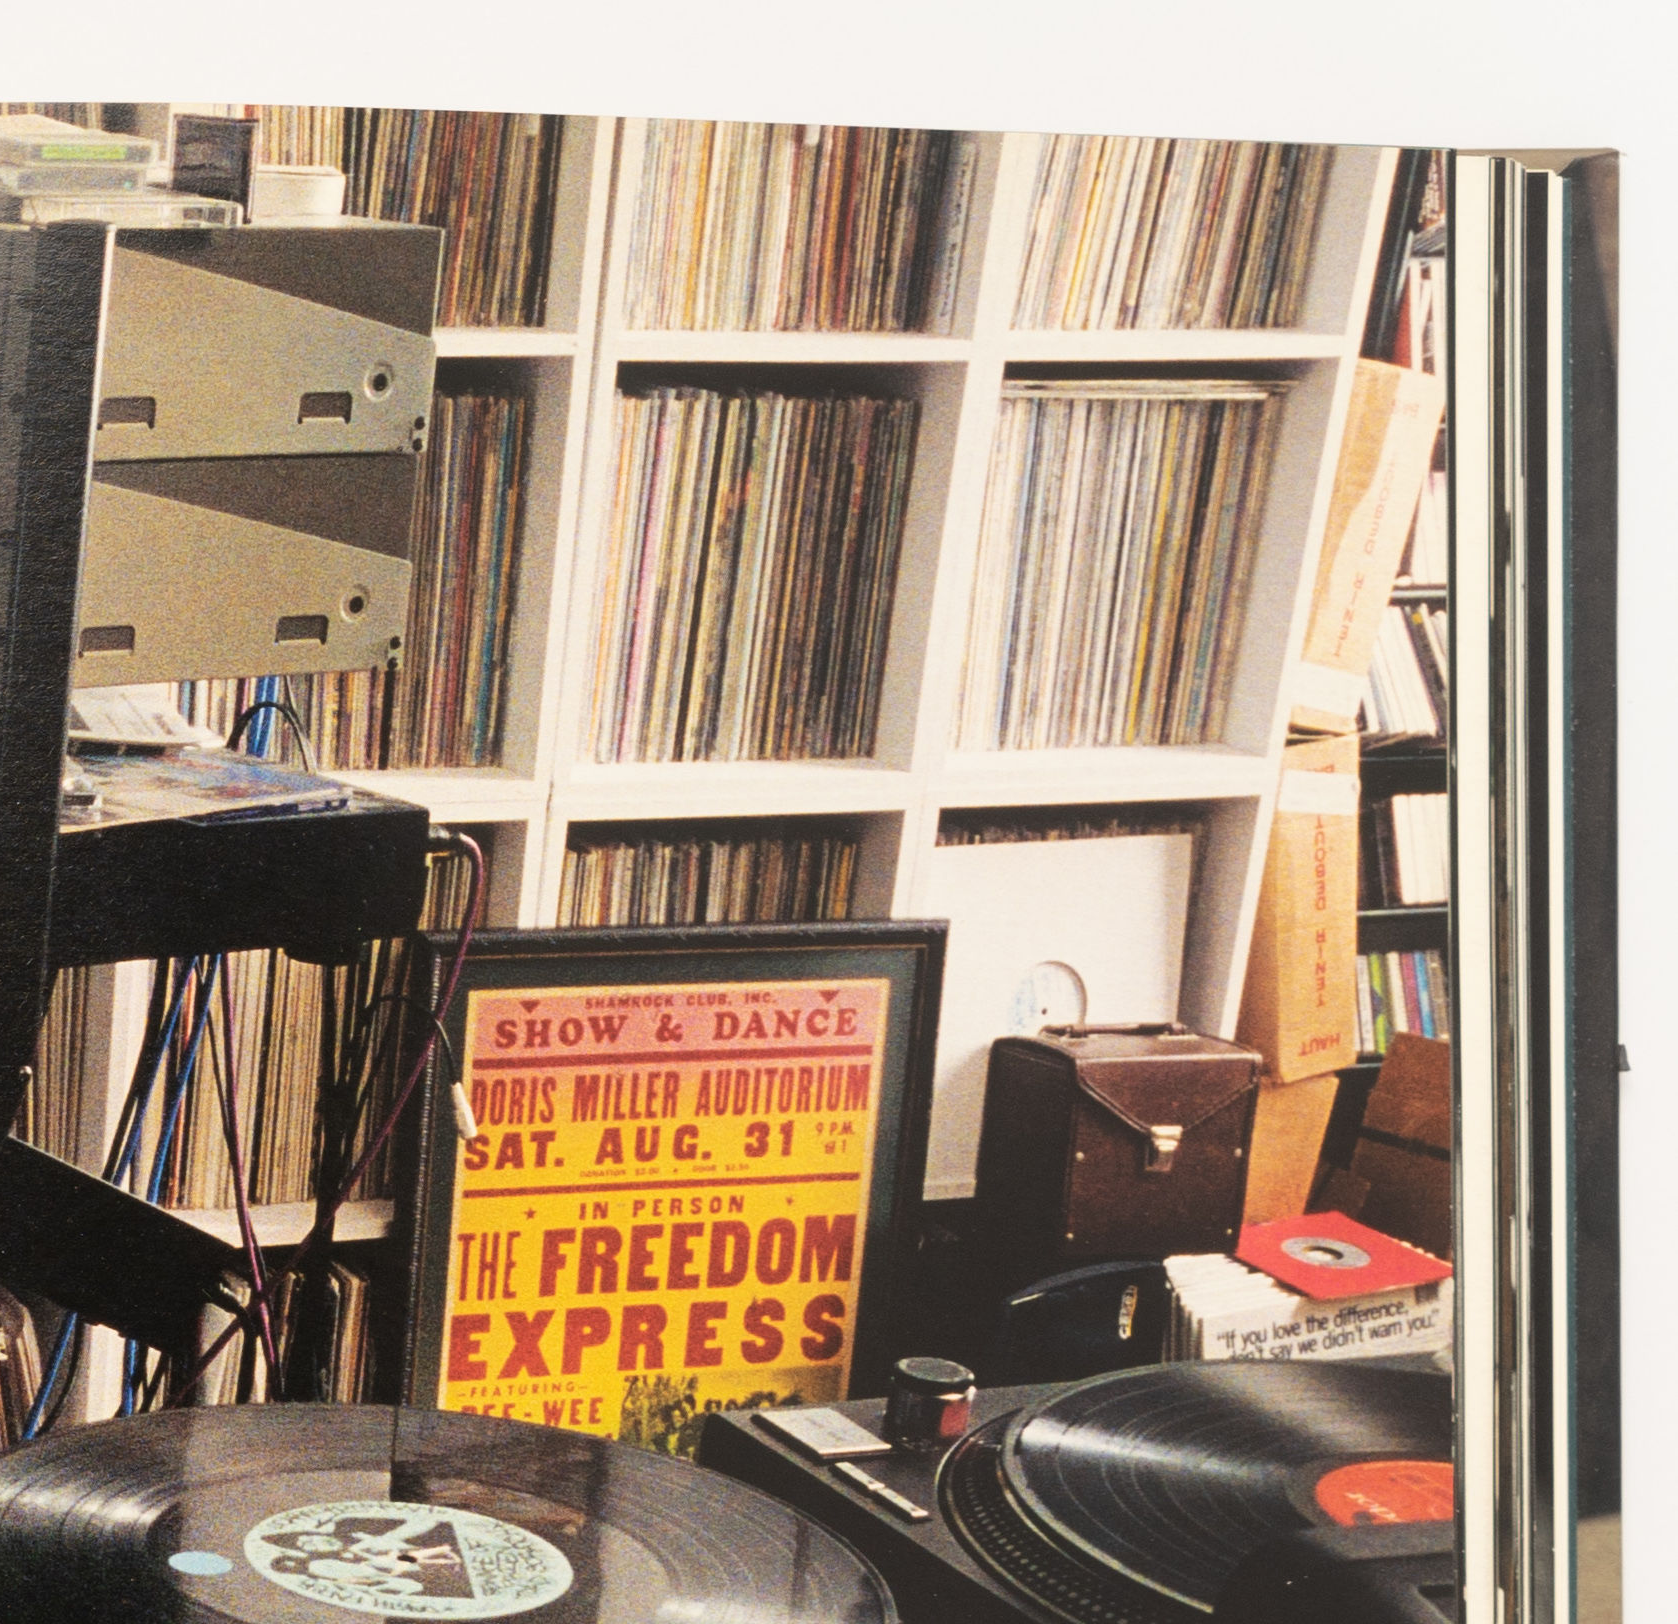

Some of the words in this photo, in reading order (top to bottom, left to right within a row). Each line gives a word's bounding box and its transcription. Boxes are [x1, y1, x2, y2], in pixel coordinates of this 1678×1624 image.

[1315, 926, 1328, 1007] TENIR
[585, 993, 675, 1010] SHAMROCK
[494, 1014, 629, 1049] SHOW
[655, 1011, 684, 1043] &
[713, 1006, 859, 1042] DANCE
[471, 1075, 558, 1127] DORIS
[571, 1070, 680, 1123] MILLER
[694, 1063, 872, 1118] AUDITORIUM
[463, 1129, 566, 1173] SAT.
[594, 1124, 713, 1166] AUG.
[744, 1119, 796, 1158] 31
[578, 1200, 609, 1221] IN
[632, 1194, 745, 1218] PERSON
[457, 1230, 521, 1302] THE
[538, 1213, 859, 1298] FREEDOM
[446, 1293, 846, 1383] EXPRESS
[1241, 1329, 1268, 1351] you
[1273, 1320, 1303, 1341] love
[1305, 1314, 1329, 1334] the
[1297, 1339, 1318, 1355] we
